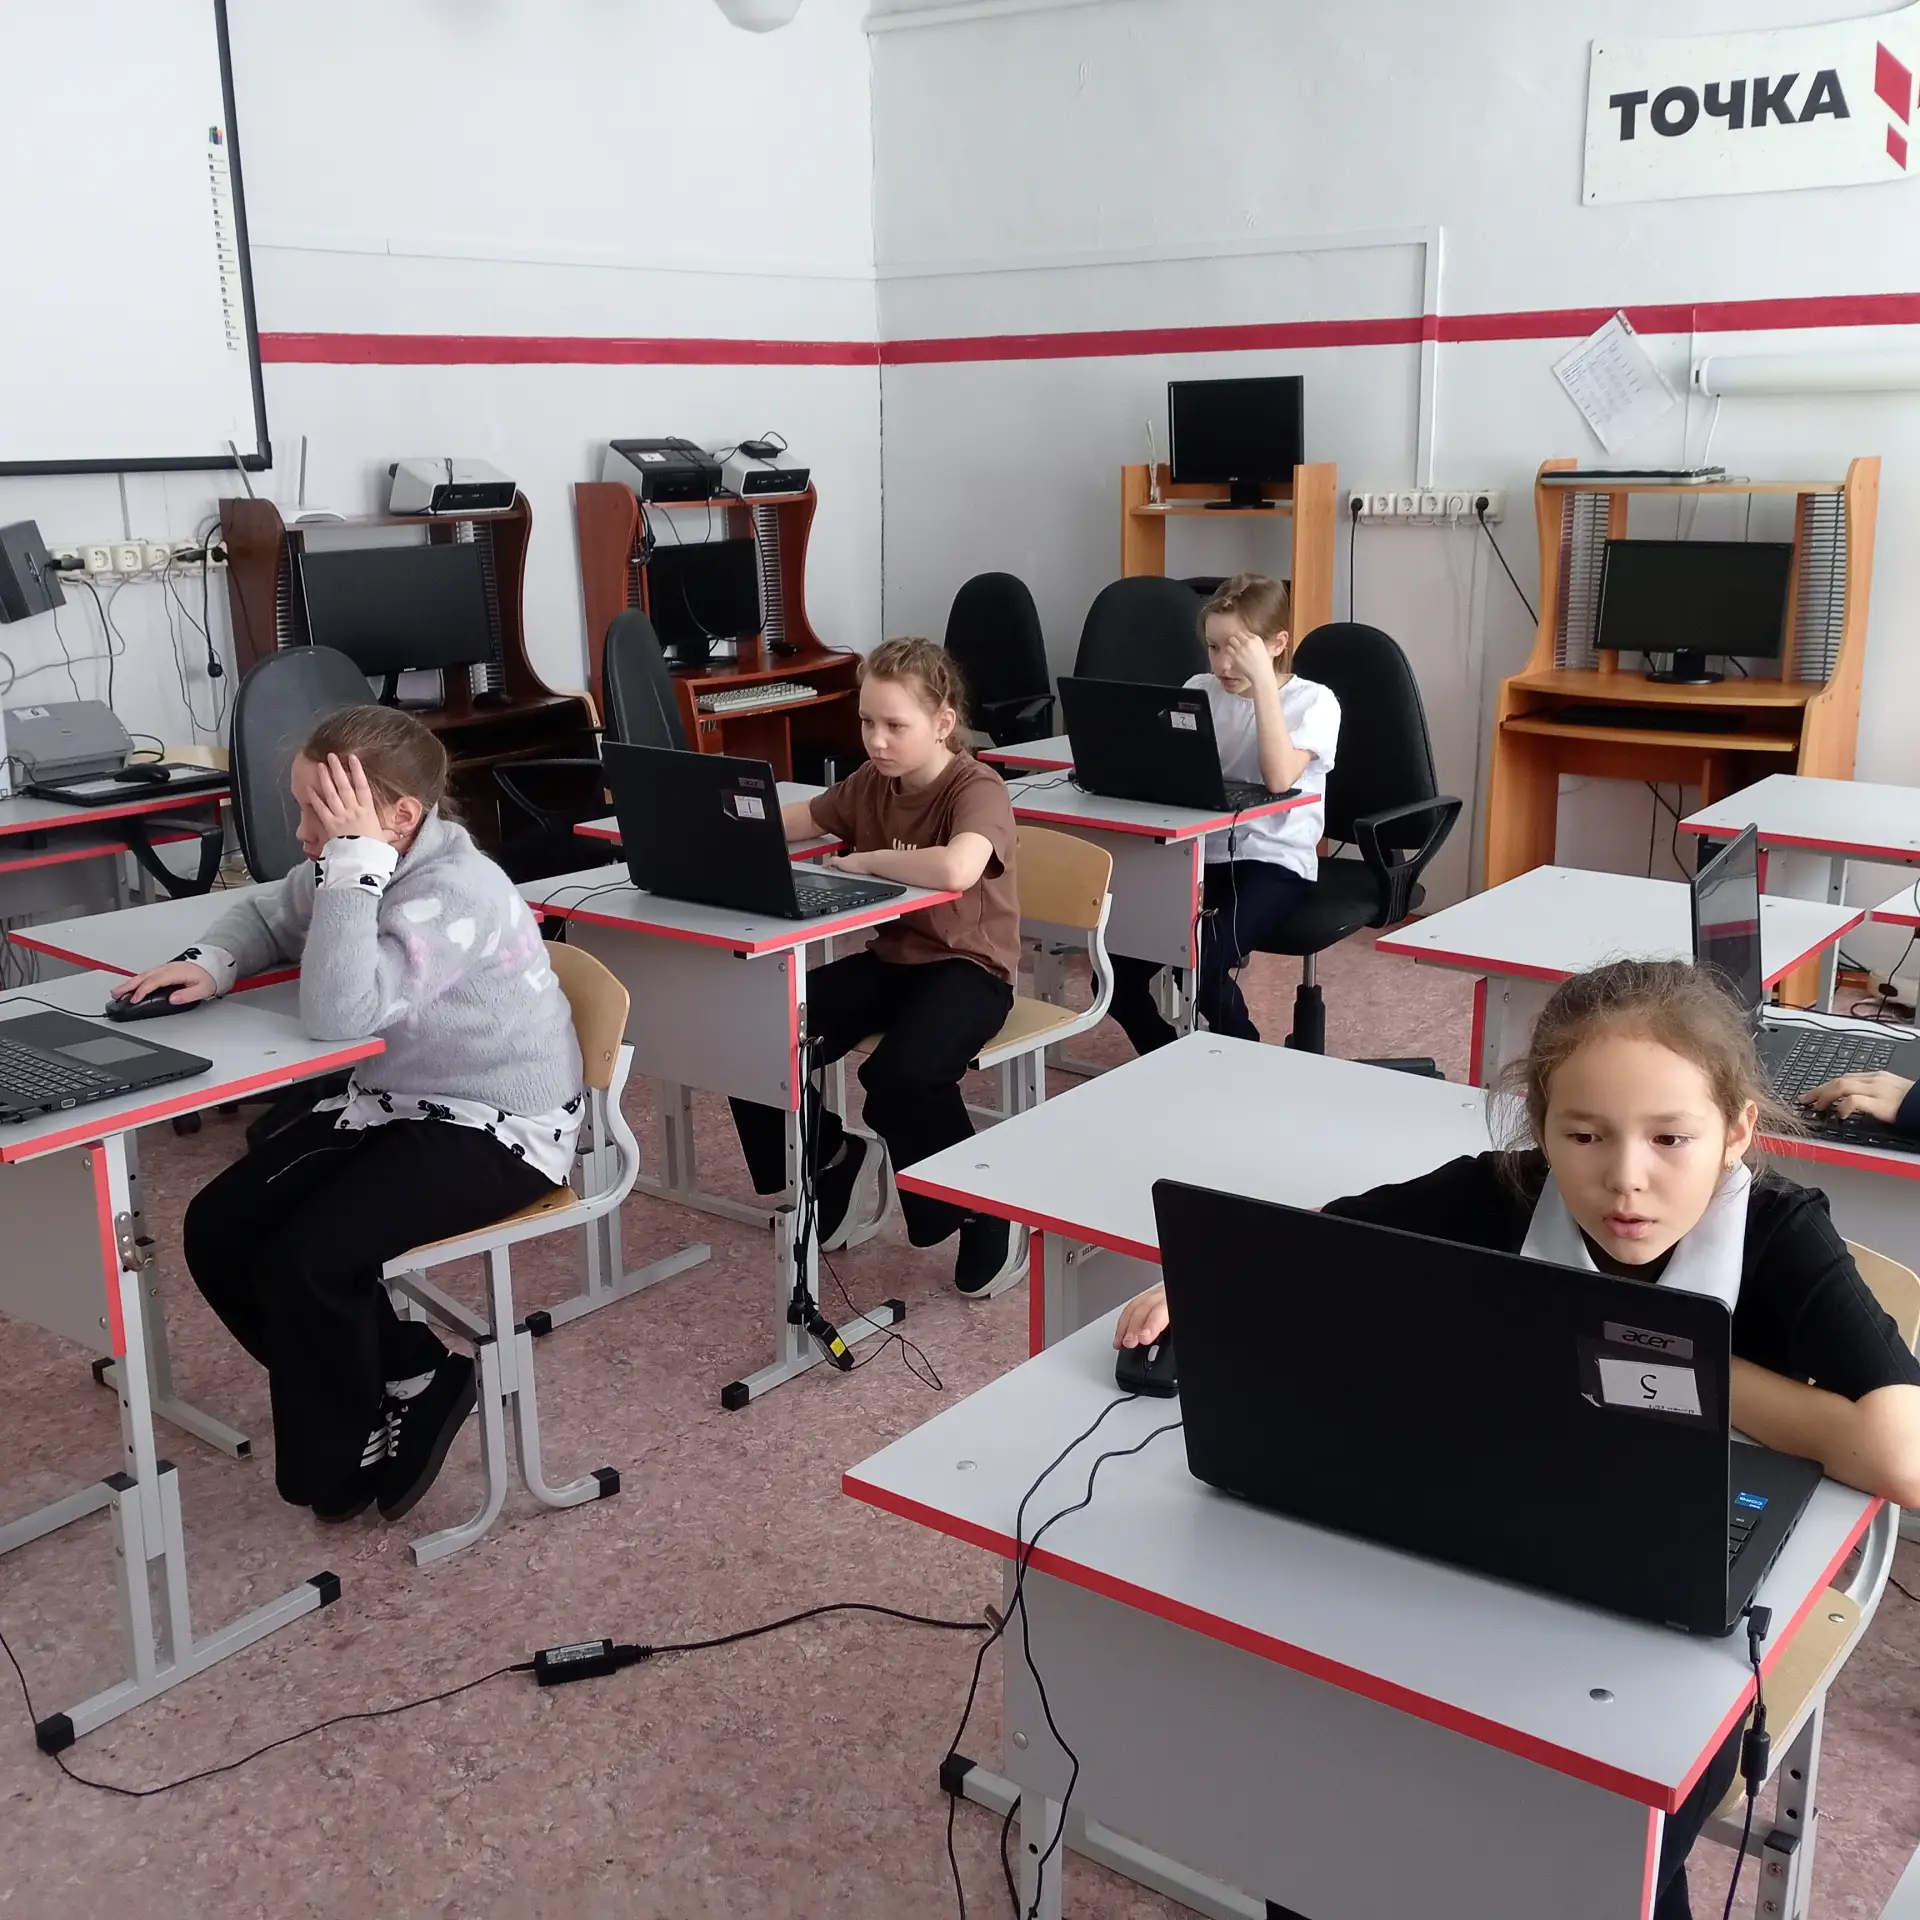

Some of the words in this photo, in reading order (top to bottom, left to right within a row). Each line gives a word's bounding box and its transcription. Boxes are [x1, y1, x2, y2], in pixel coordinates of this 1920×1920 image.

[1609, 68, 1850, 141] ТОЧКА
[1621, 1330, 1675, 1349] acer
[1640, 1374, 1657, 1400] 5
